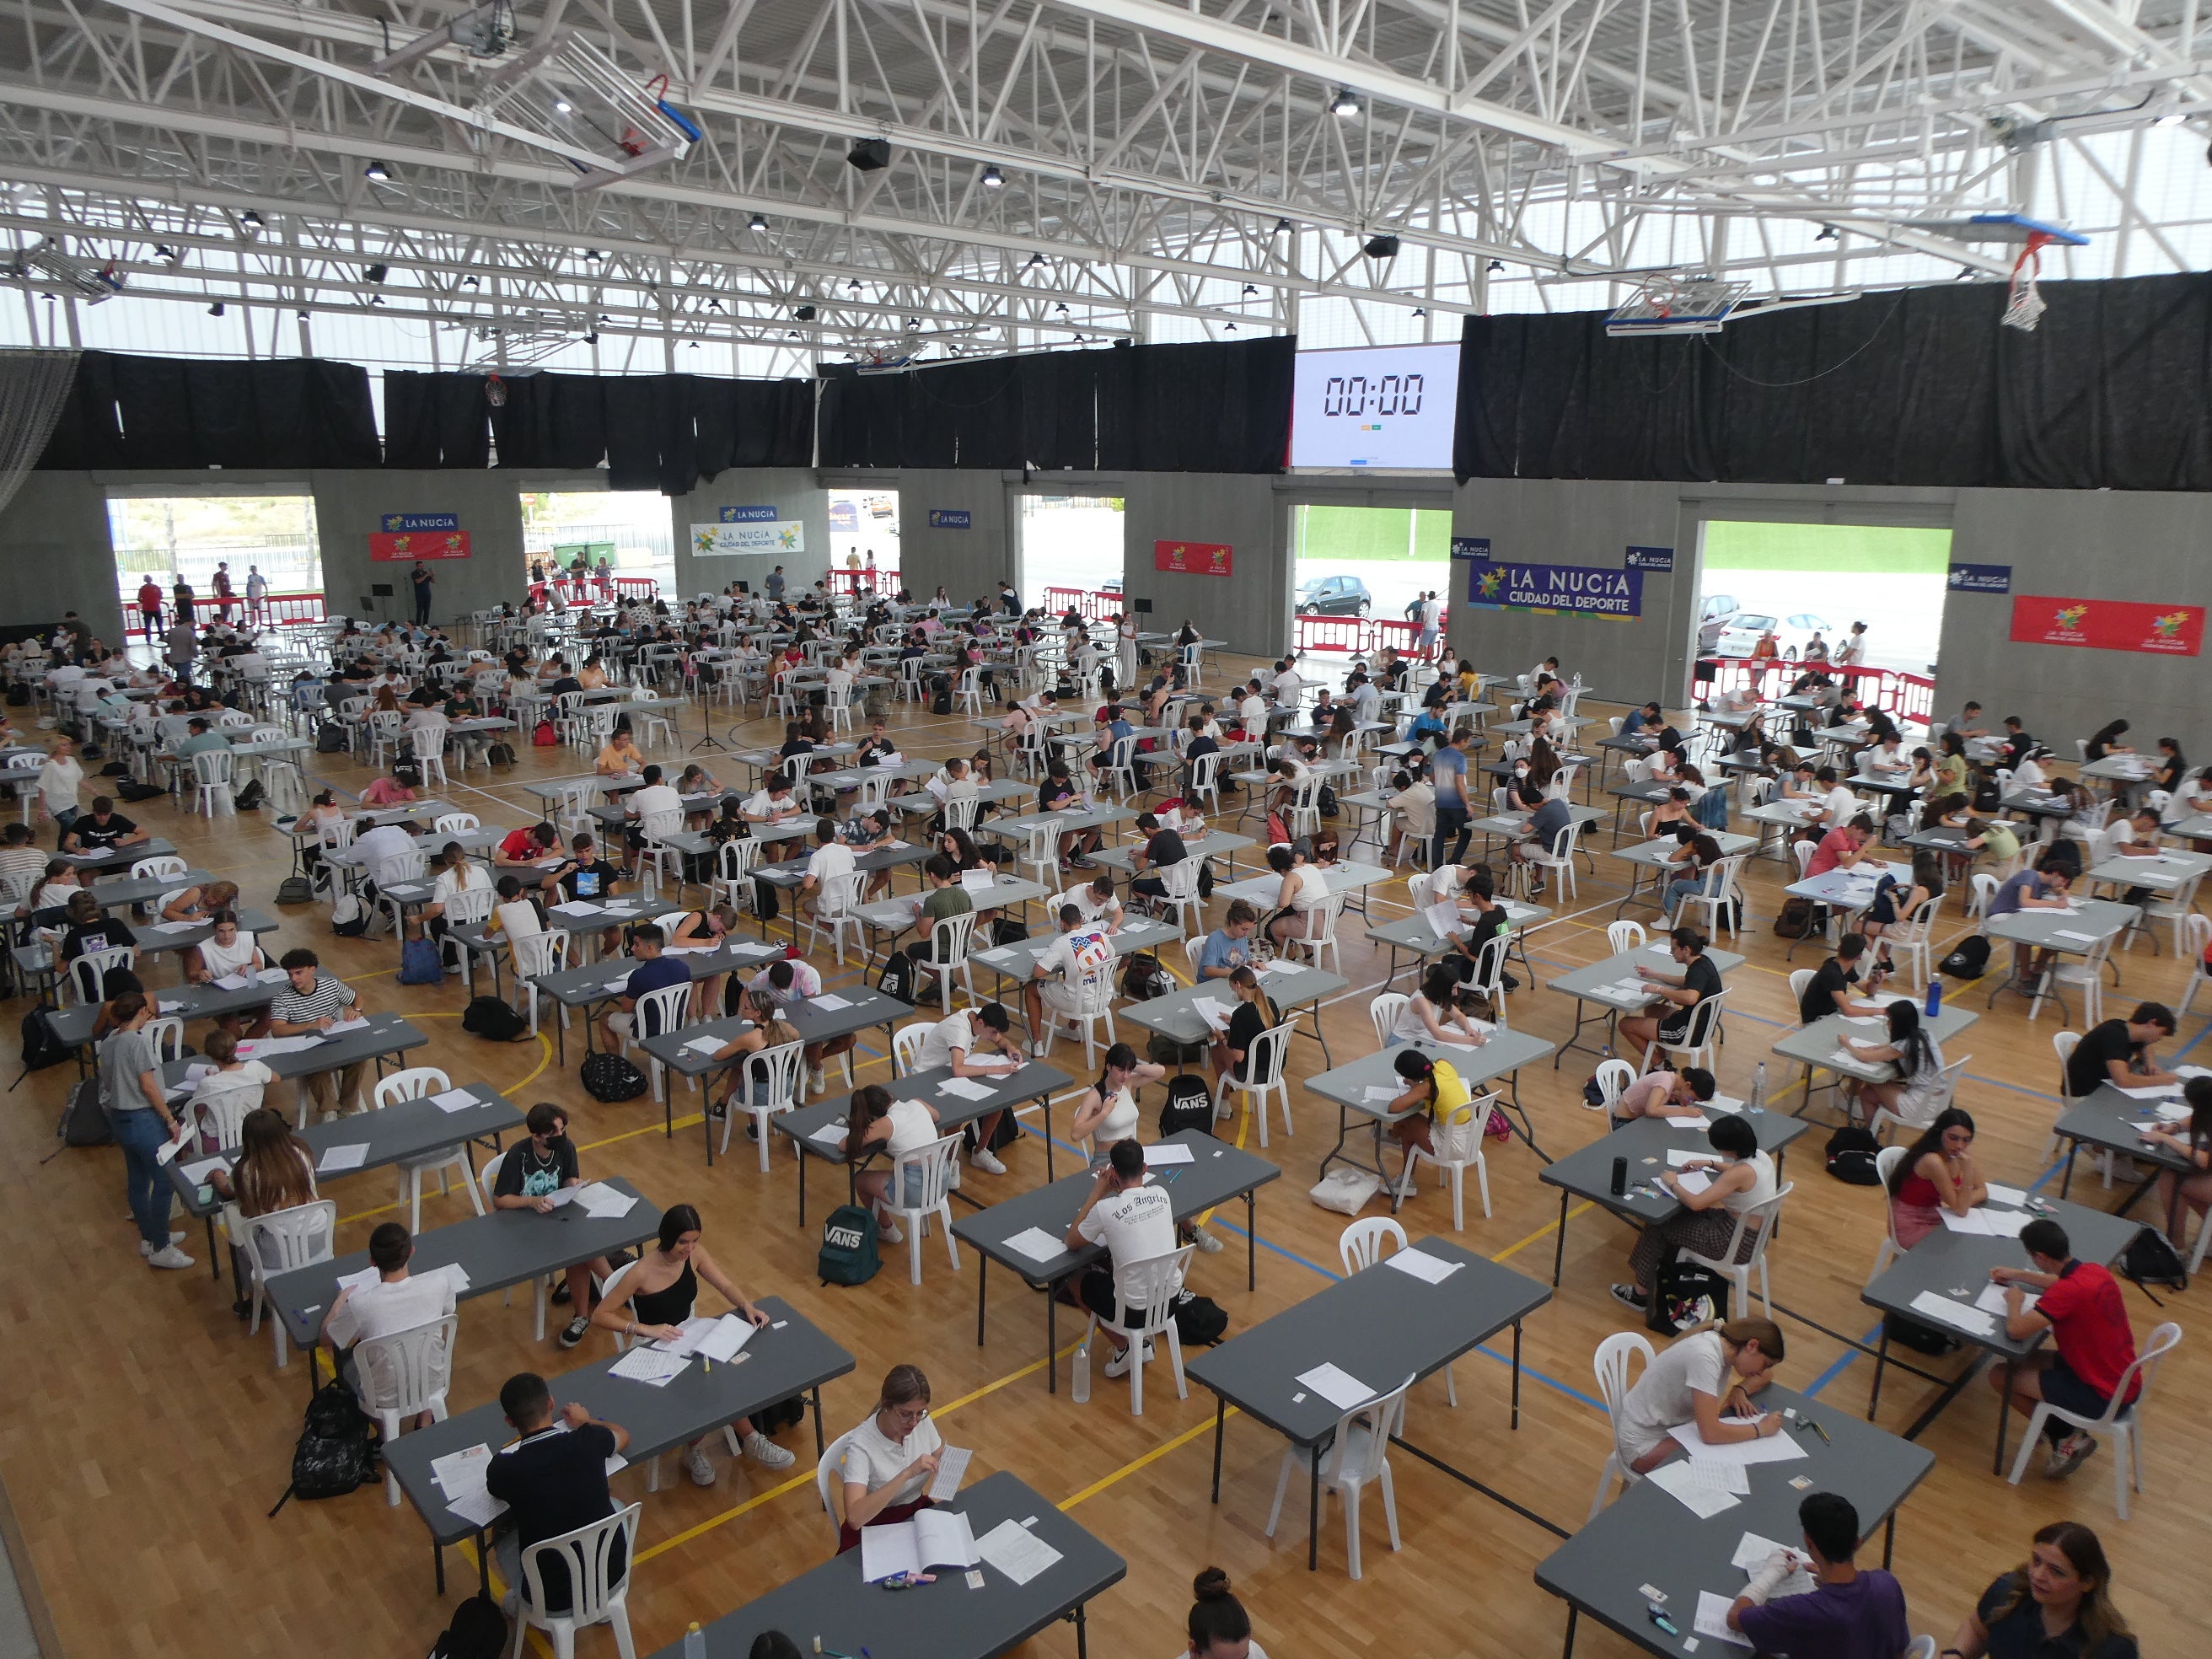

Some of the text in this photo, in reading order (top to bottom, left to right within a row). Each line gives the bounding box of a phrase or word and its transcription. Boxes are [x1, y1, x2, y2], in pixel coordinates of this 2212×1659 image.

[1324, 374, 1424, 416] 00:00
[405, 519, 418, 528] LA
[941, 515, 948, 523] LA
[1510, 569, 1535, 589] LA
[1508, 591, 1630, 612] CIUDAD DEL DEPORTE
[1173, 1092, 1208, 1110] VANS
[1112, 1203, 1133, 1221] Los
[1133, 1194, 1168, 1206] Angeles
[824, 1222, 864, 1248] VANS
